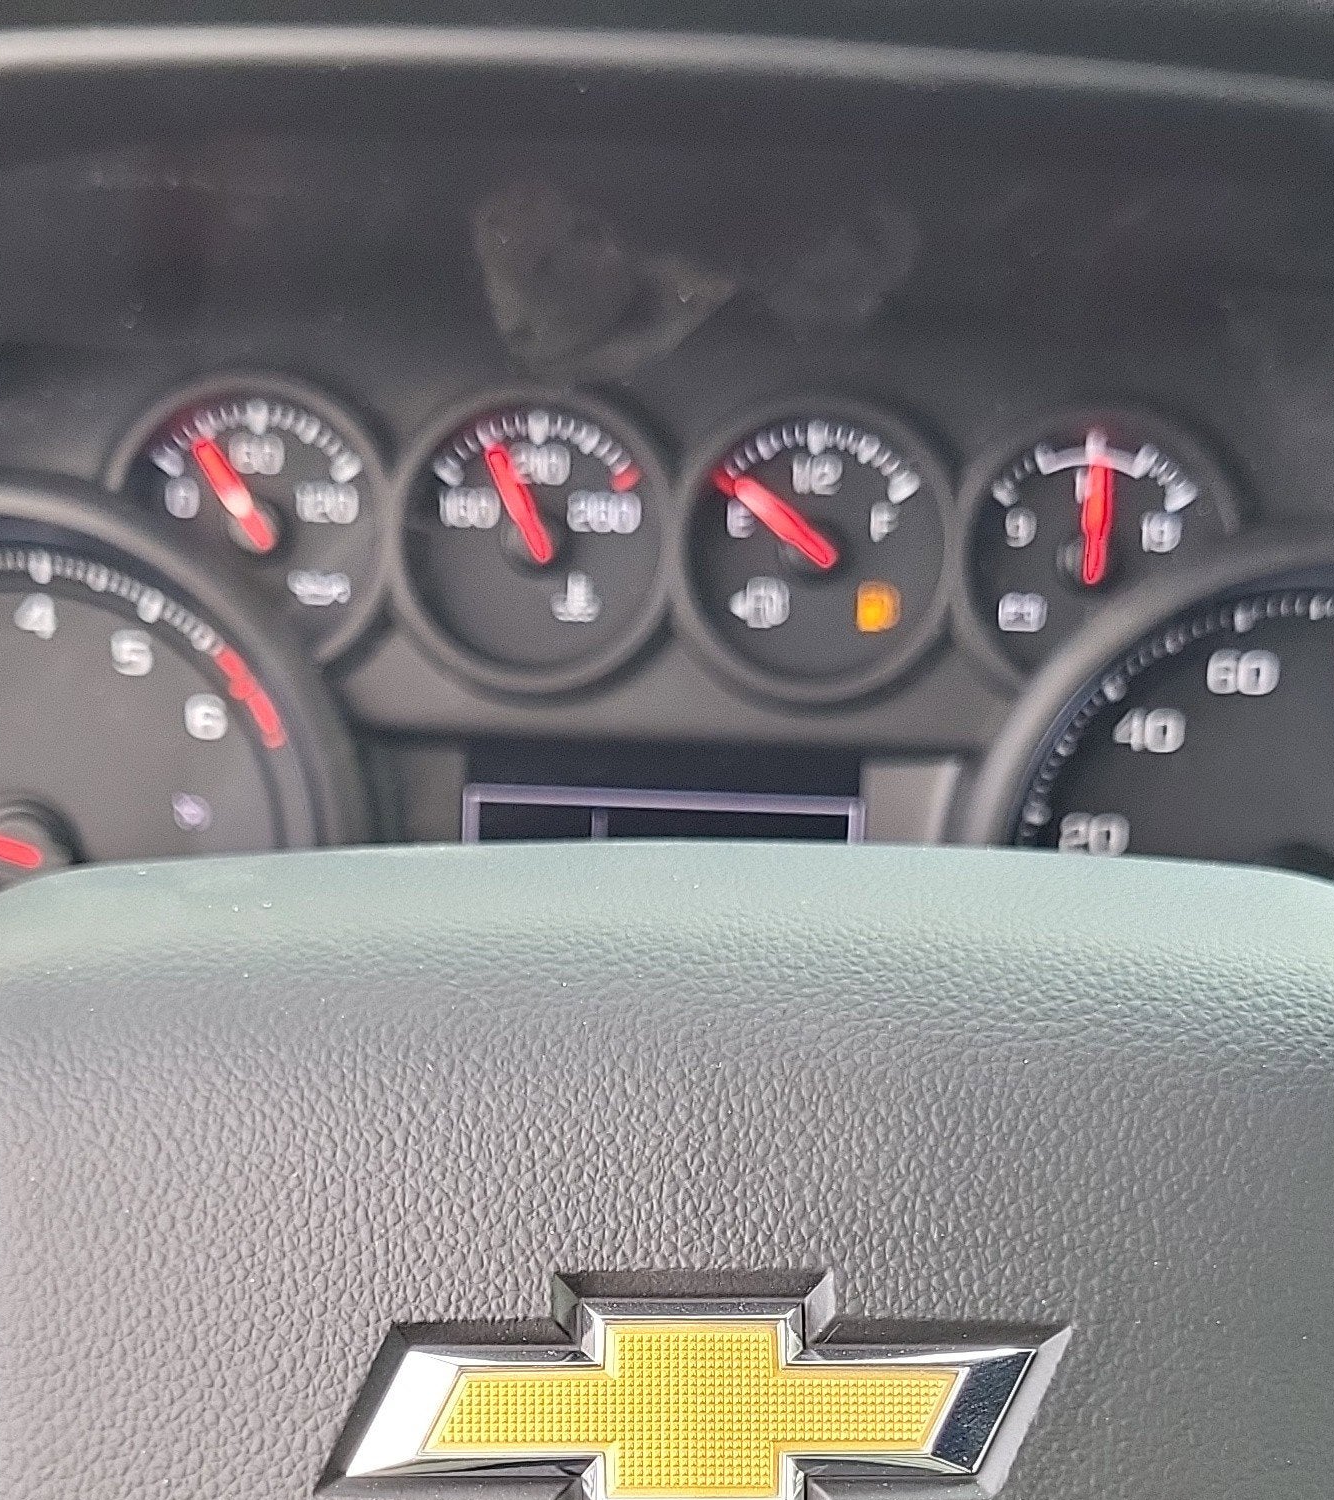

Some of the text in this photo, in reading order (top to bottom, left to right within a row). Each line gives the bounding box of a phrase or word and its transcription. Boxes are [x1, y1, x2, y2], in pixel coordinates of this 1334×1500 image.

[1005, 507, 1037, 547] 9
[14, 593, 58, 639] 4
[110, 628, 153, 676] 5
[1207, 649, 1281, 695] 60
[184, 693, 228, 741] 6
[1113, 707, 1186, 753] 40
[1058, 812, 1129, 857] 20
